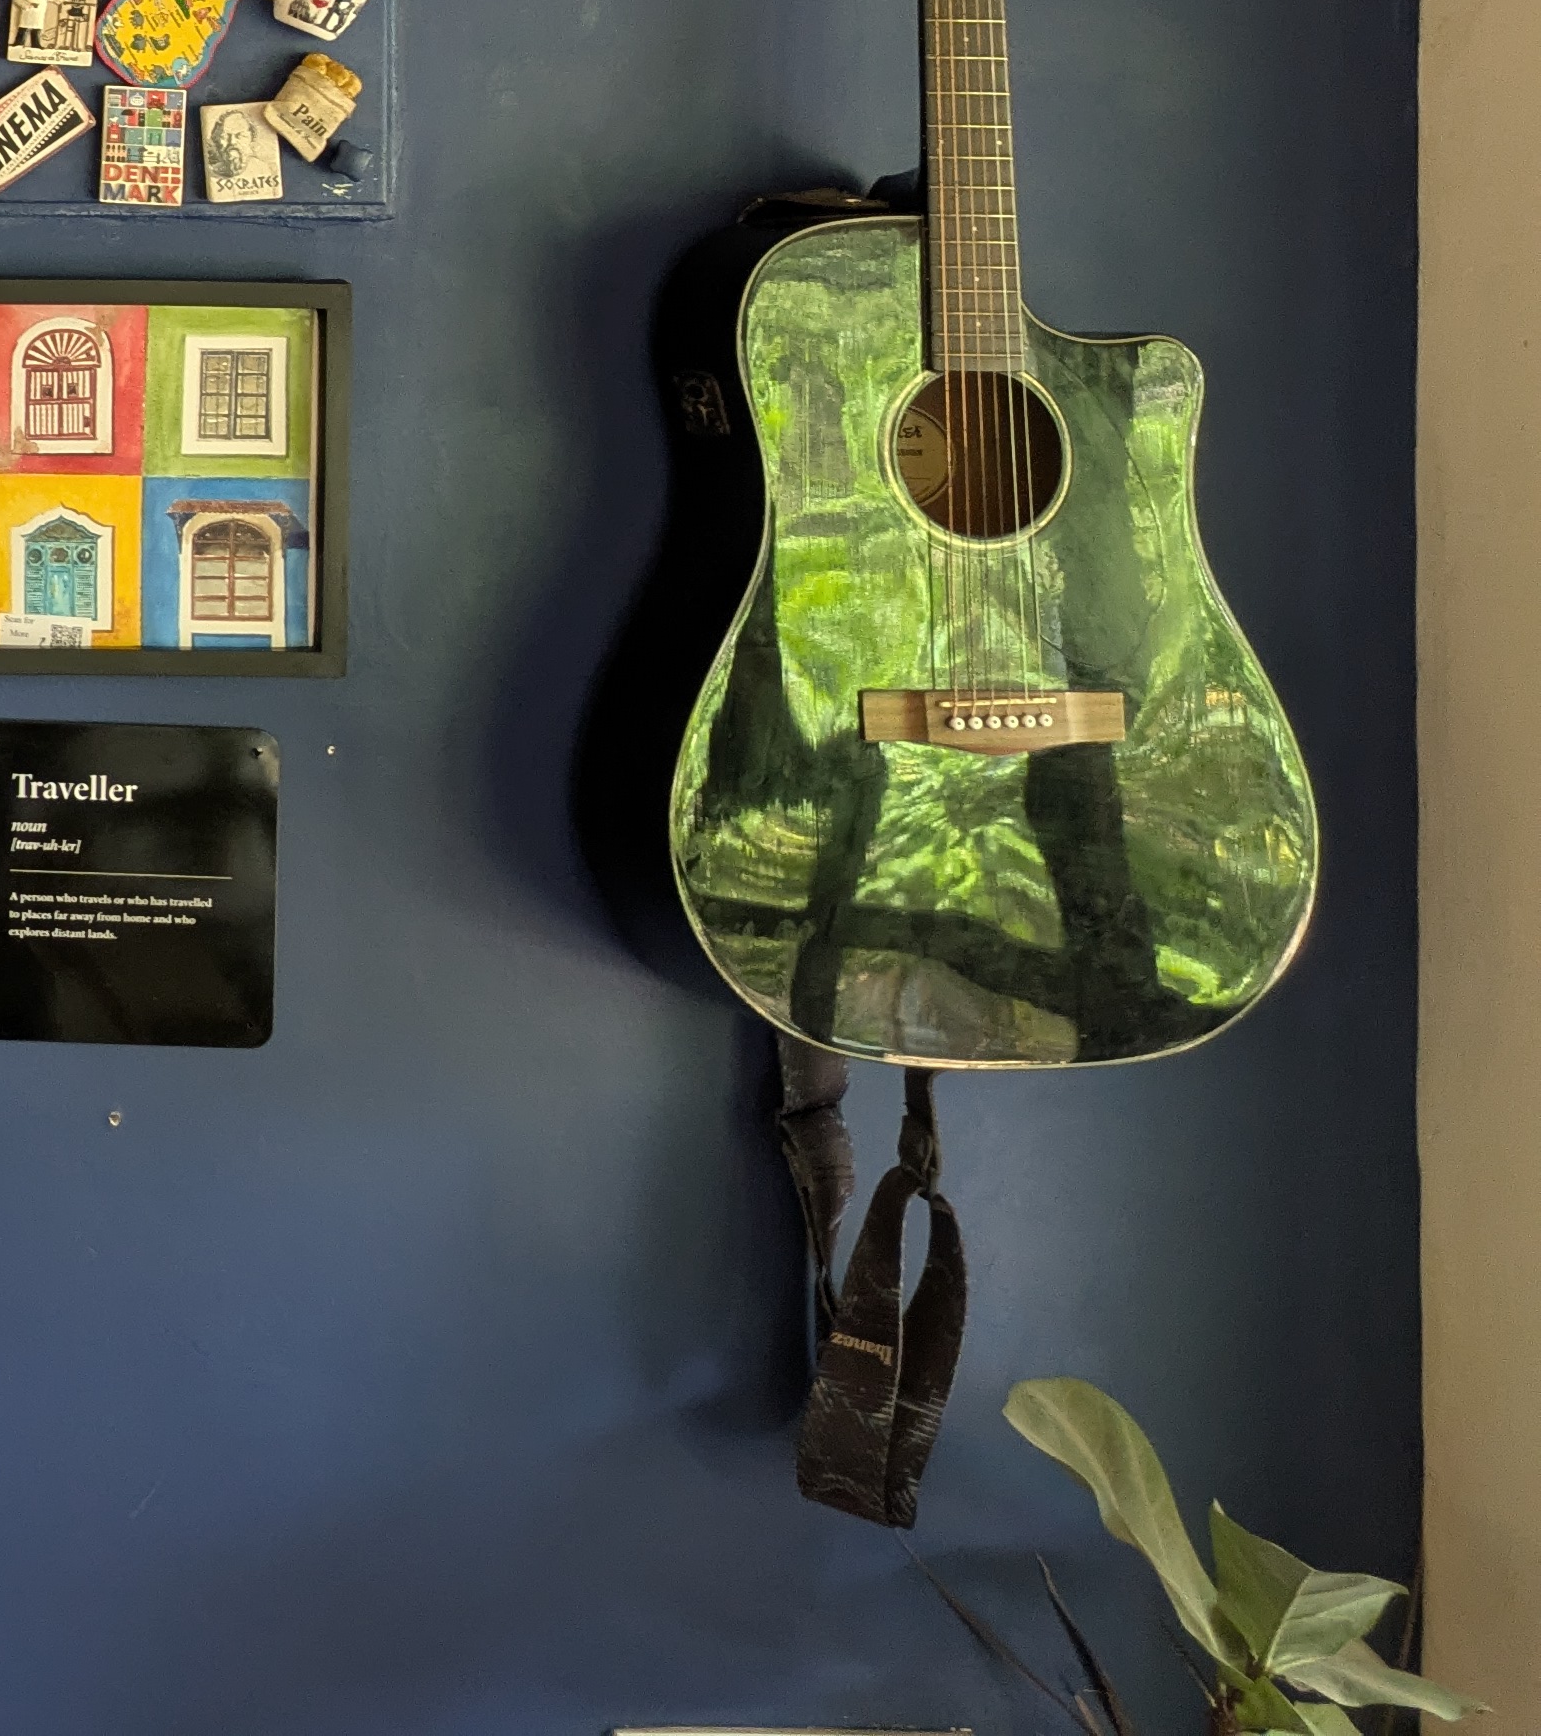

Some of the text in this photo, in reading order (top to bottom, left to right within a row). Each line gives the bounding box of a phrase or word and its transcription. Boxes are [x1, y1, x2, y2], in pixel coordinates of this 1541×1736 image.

[293, 103, 327, 137] Pain
[104, 164, 160, 184] DEN
[216, 175, 280, 192] SOCRATES
[103, 184, 180, 204] MARK
[11, 772, 139, 802] Traveller
[11, 820, 48, 833] noun
[9, 892, 213, 908] A person who travels or who has travelled
[8, 910, 197, 925] to places far away from home and who
[8, 927, 118, 939] explores distant lands.
[829, 1331, 894, 1367] Ibanez
